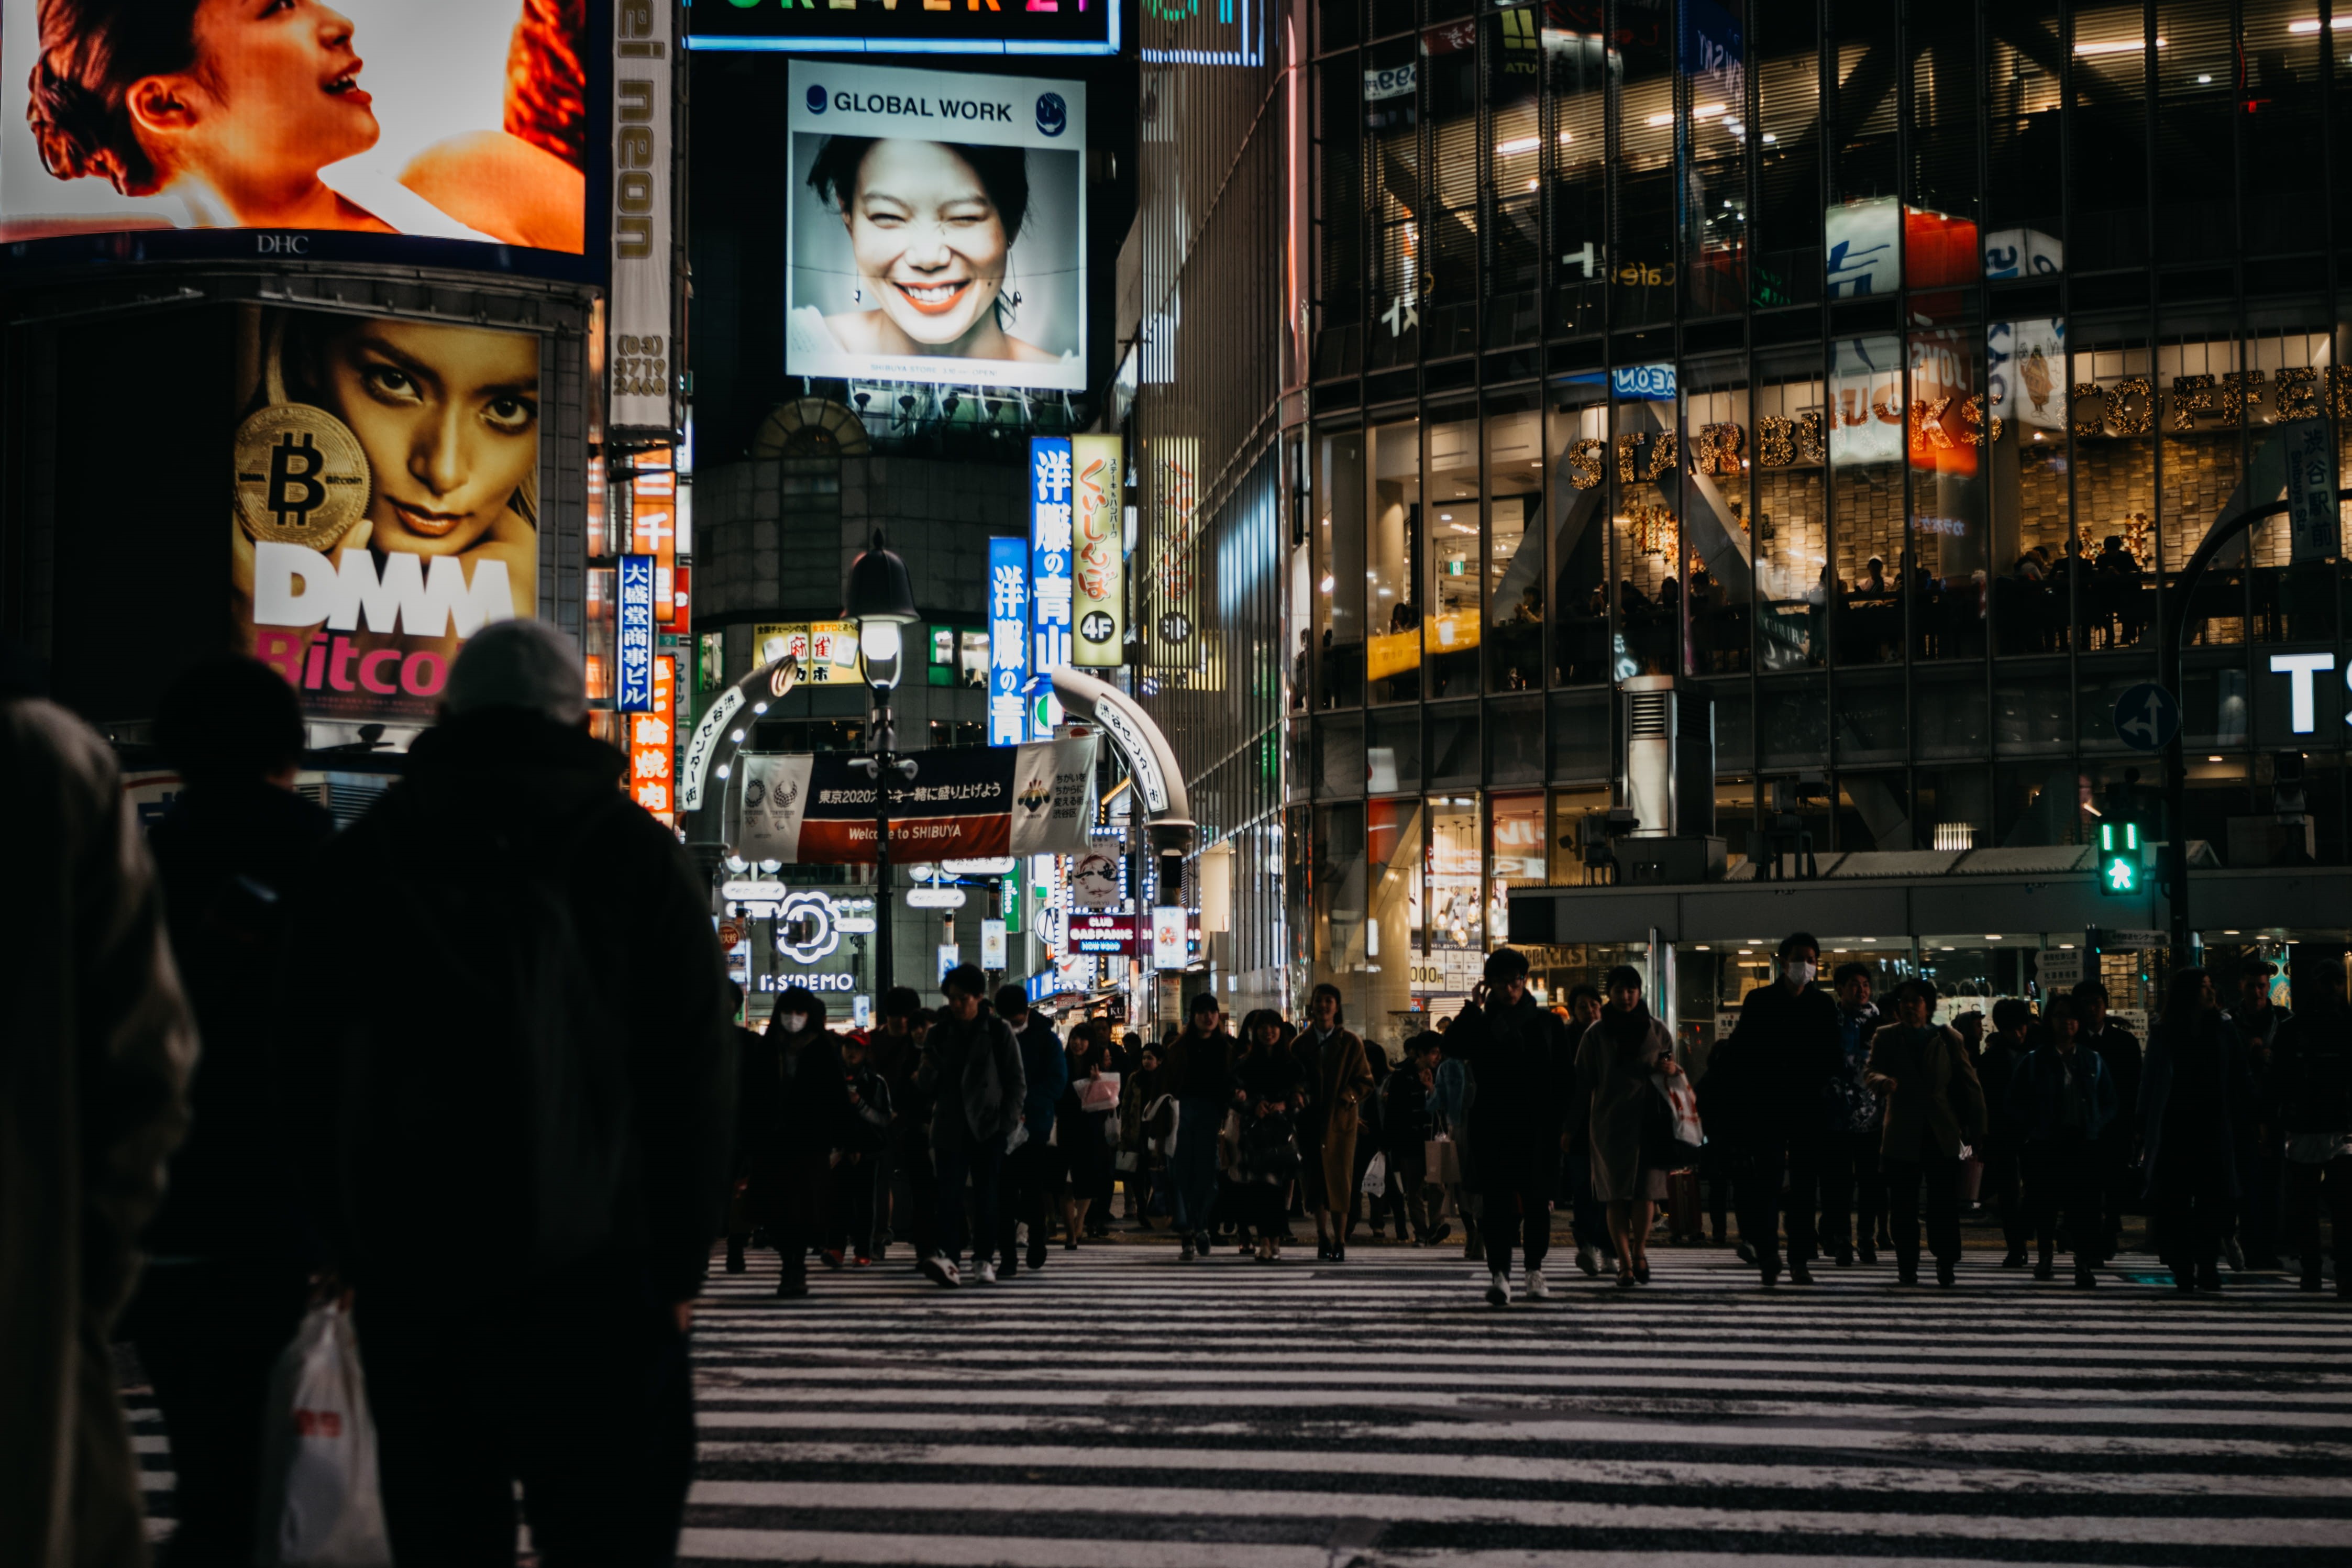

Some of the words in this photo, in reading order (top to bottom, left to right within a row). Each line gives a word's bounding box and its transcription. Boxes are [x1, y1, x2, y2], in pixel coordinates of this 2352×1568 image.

[834, 92, 934, 117] GLOBAL
[939, 98, 1013, 123] WORK
[618, 80, 654, 259] neon
[257, 234, 309, 254] DHC
[617, 335, 663, 357] (03)
[614, 358, 666, 377] 3719
[613, 377, 666, 396] 2468
[326, 476, 362, 484] Bitcoin
[2291, 450, 2303, 505] Shibuya
[2304, 429, 2332, 548] 渋谷駅前
[253, 540, 515, 638] DMM
[624, 564, 649, 704] 大盛堂商事ビル
[1081, 614, 1112, 639] 4F
[255, 630, 453, 697] Bitco
[1055, 785, 1084, 795] ちからに
[1056, 774, 1086, 783] ちがいを
[1052, 808, 1077, 819] 渋谷区
[848, 826, 894, 840] Welcoe
[898, 827, 909, 838] to
[912, 824, 962, 838] SHIBUYA
[1004, 879, 1018, 914] mineo
